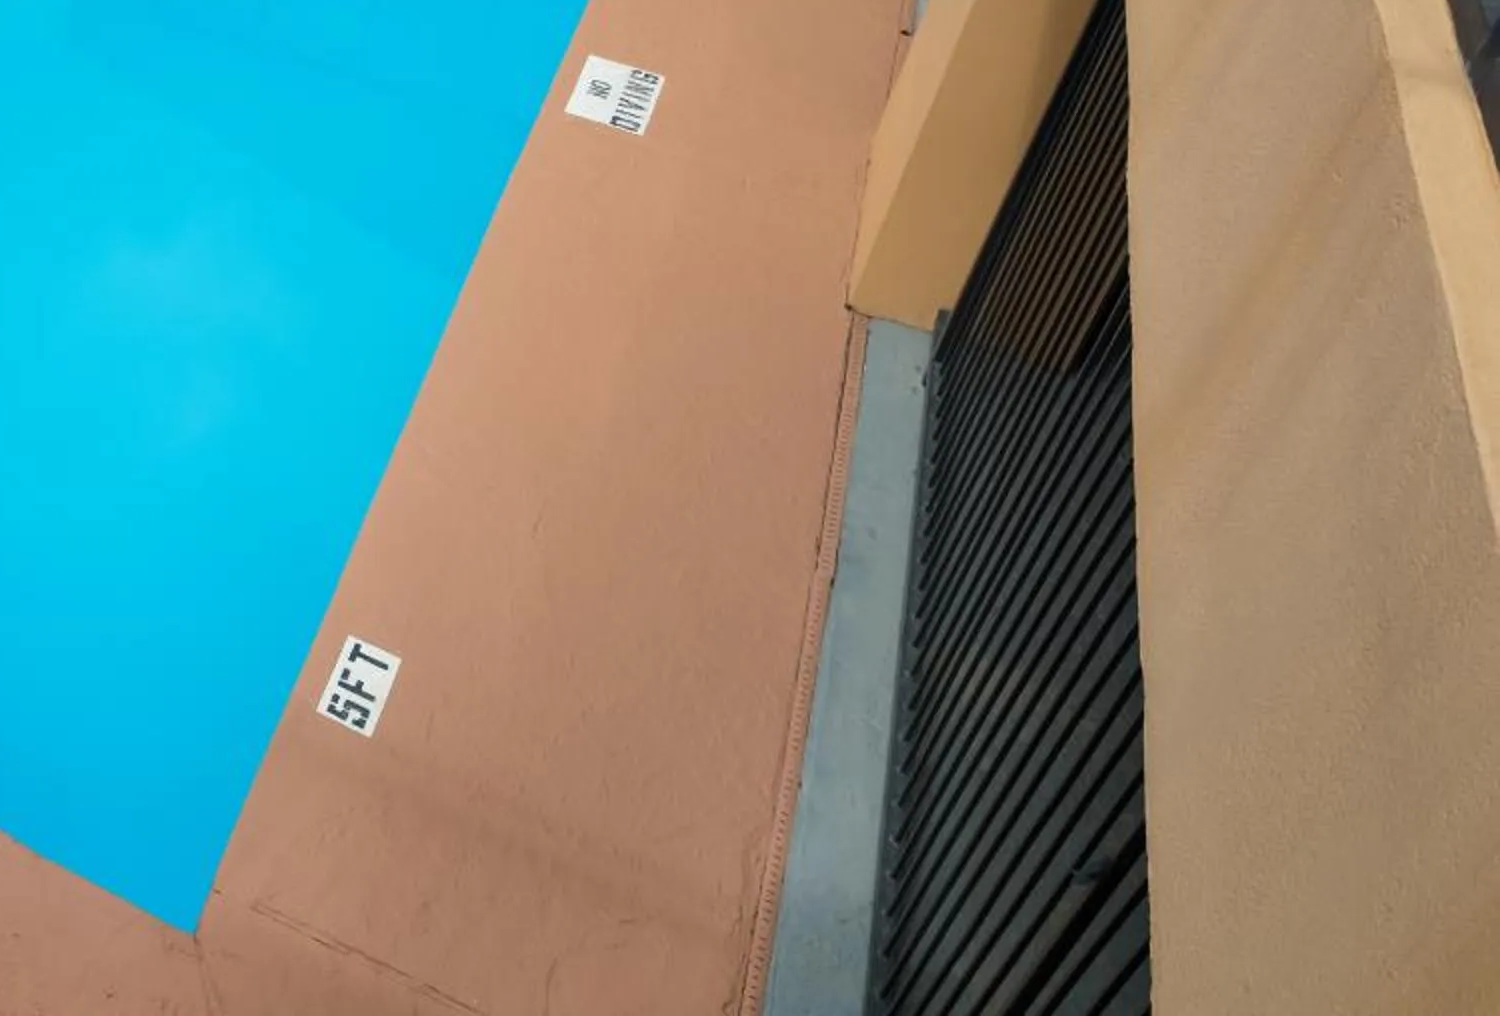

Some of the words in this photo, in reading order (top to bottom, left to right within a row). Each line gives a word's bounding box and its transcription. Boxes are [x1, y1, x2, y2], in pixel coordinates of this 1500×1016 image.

[586, 79, 612, 100] NO
[609, 69, 659, 133] DIVING
[326, 642, 390, 730] 5FT
